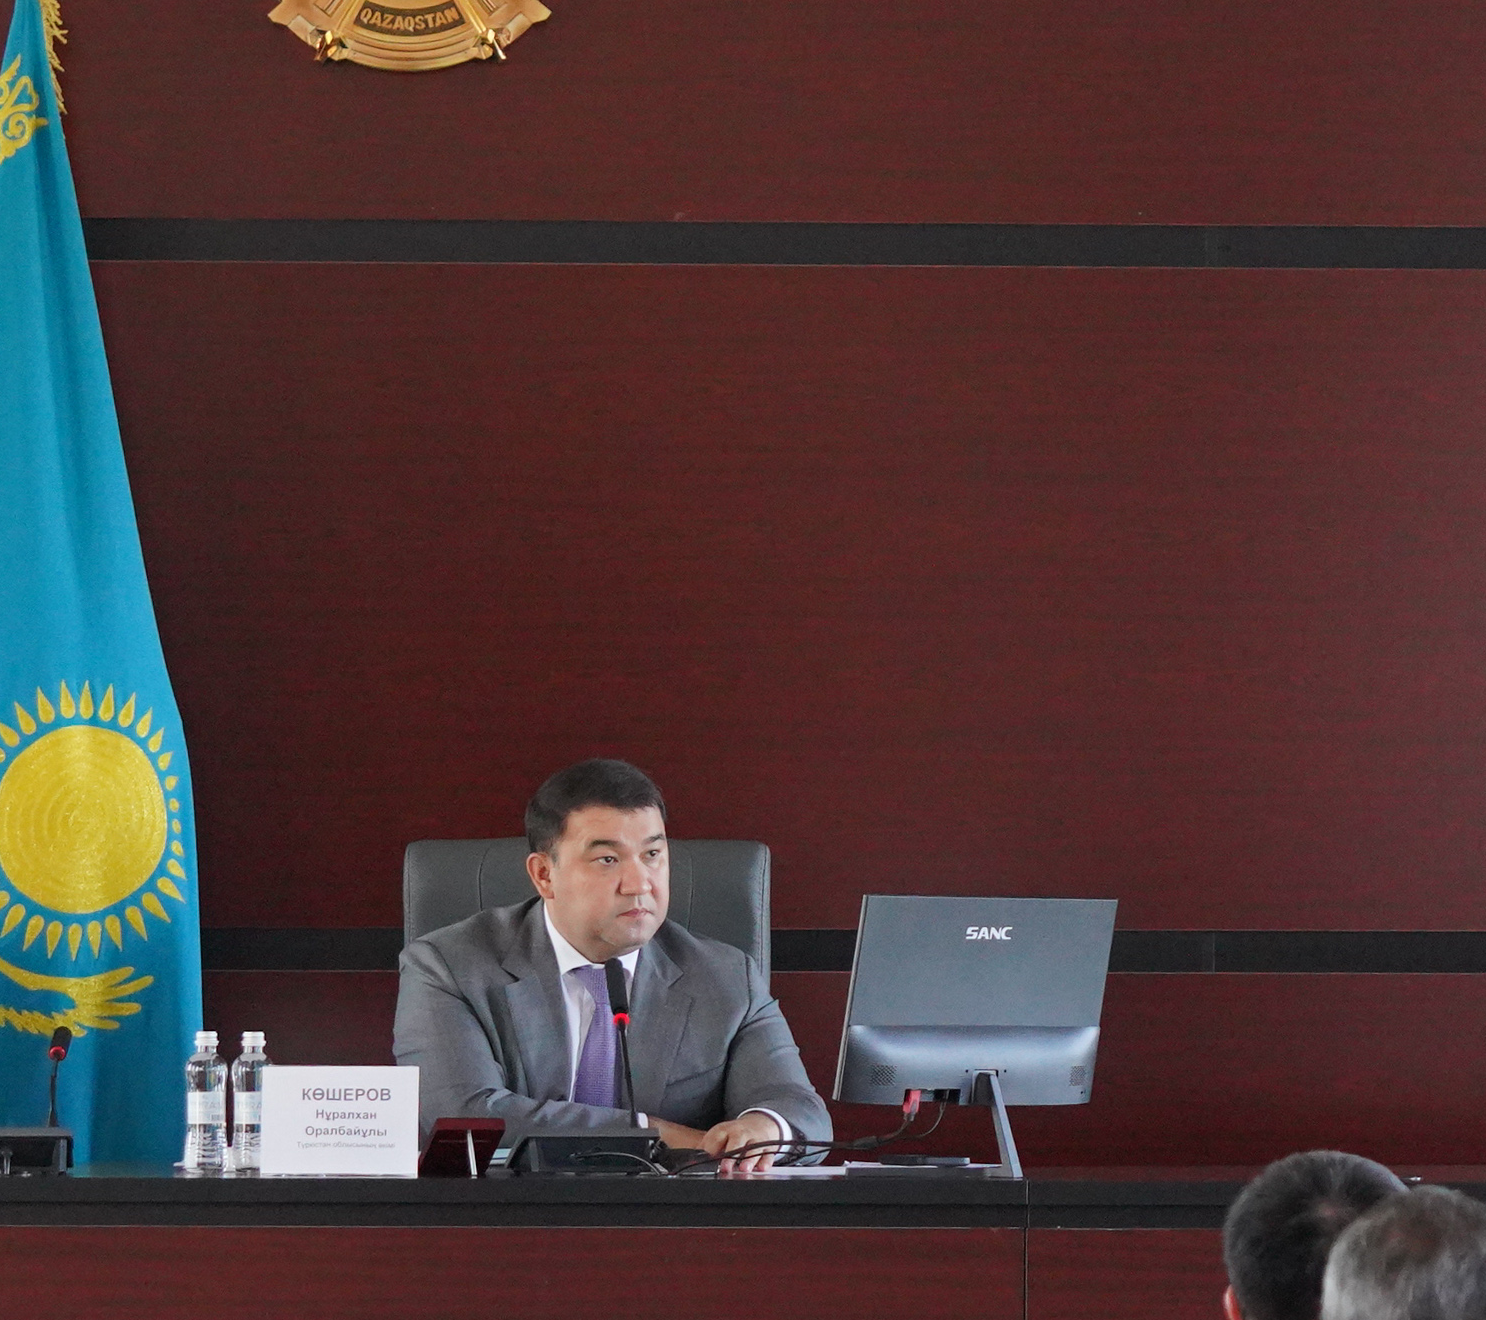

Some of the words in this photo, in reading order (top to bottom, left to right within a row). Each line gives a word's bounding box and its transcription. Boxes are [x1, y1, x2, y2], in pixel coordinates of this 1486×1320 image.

[359, 6, 460, 33] QAZAQSTAN
[965, 926, 1013, 940] SANC
[302, 1087, 392, 1101] КӨШЕРОВ
[315, 1109, 377, 1121] Нұралхан
[305, 1125, 388, 1138] Оралбайұлы
